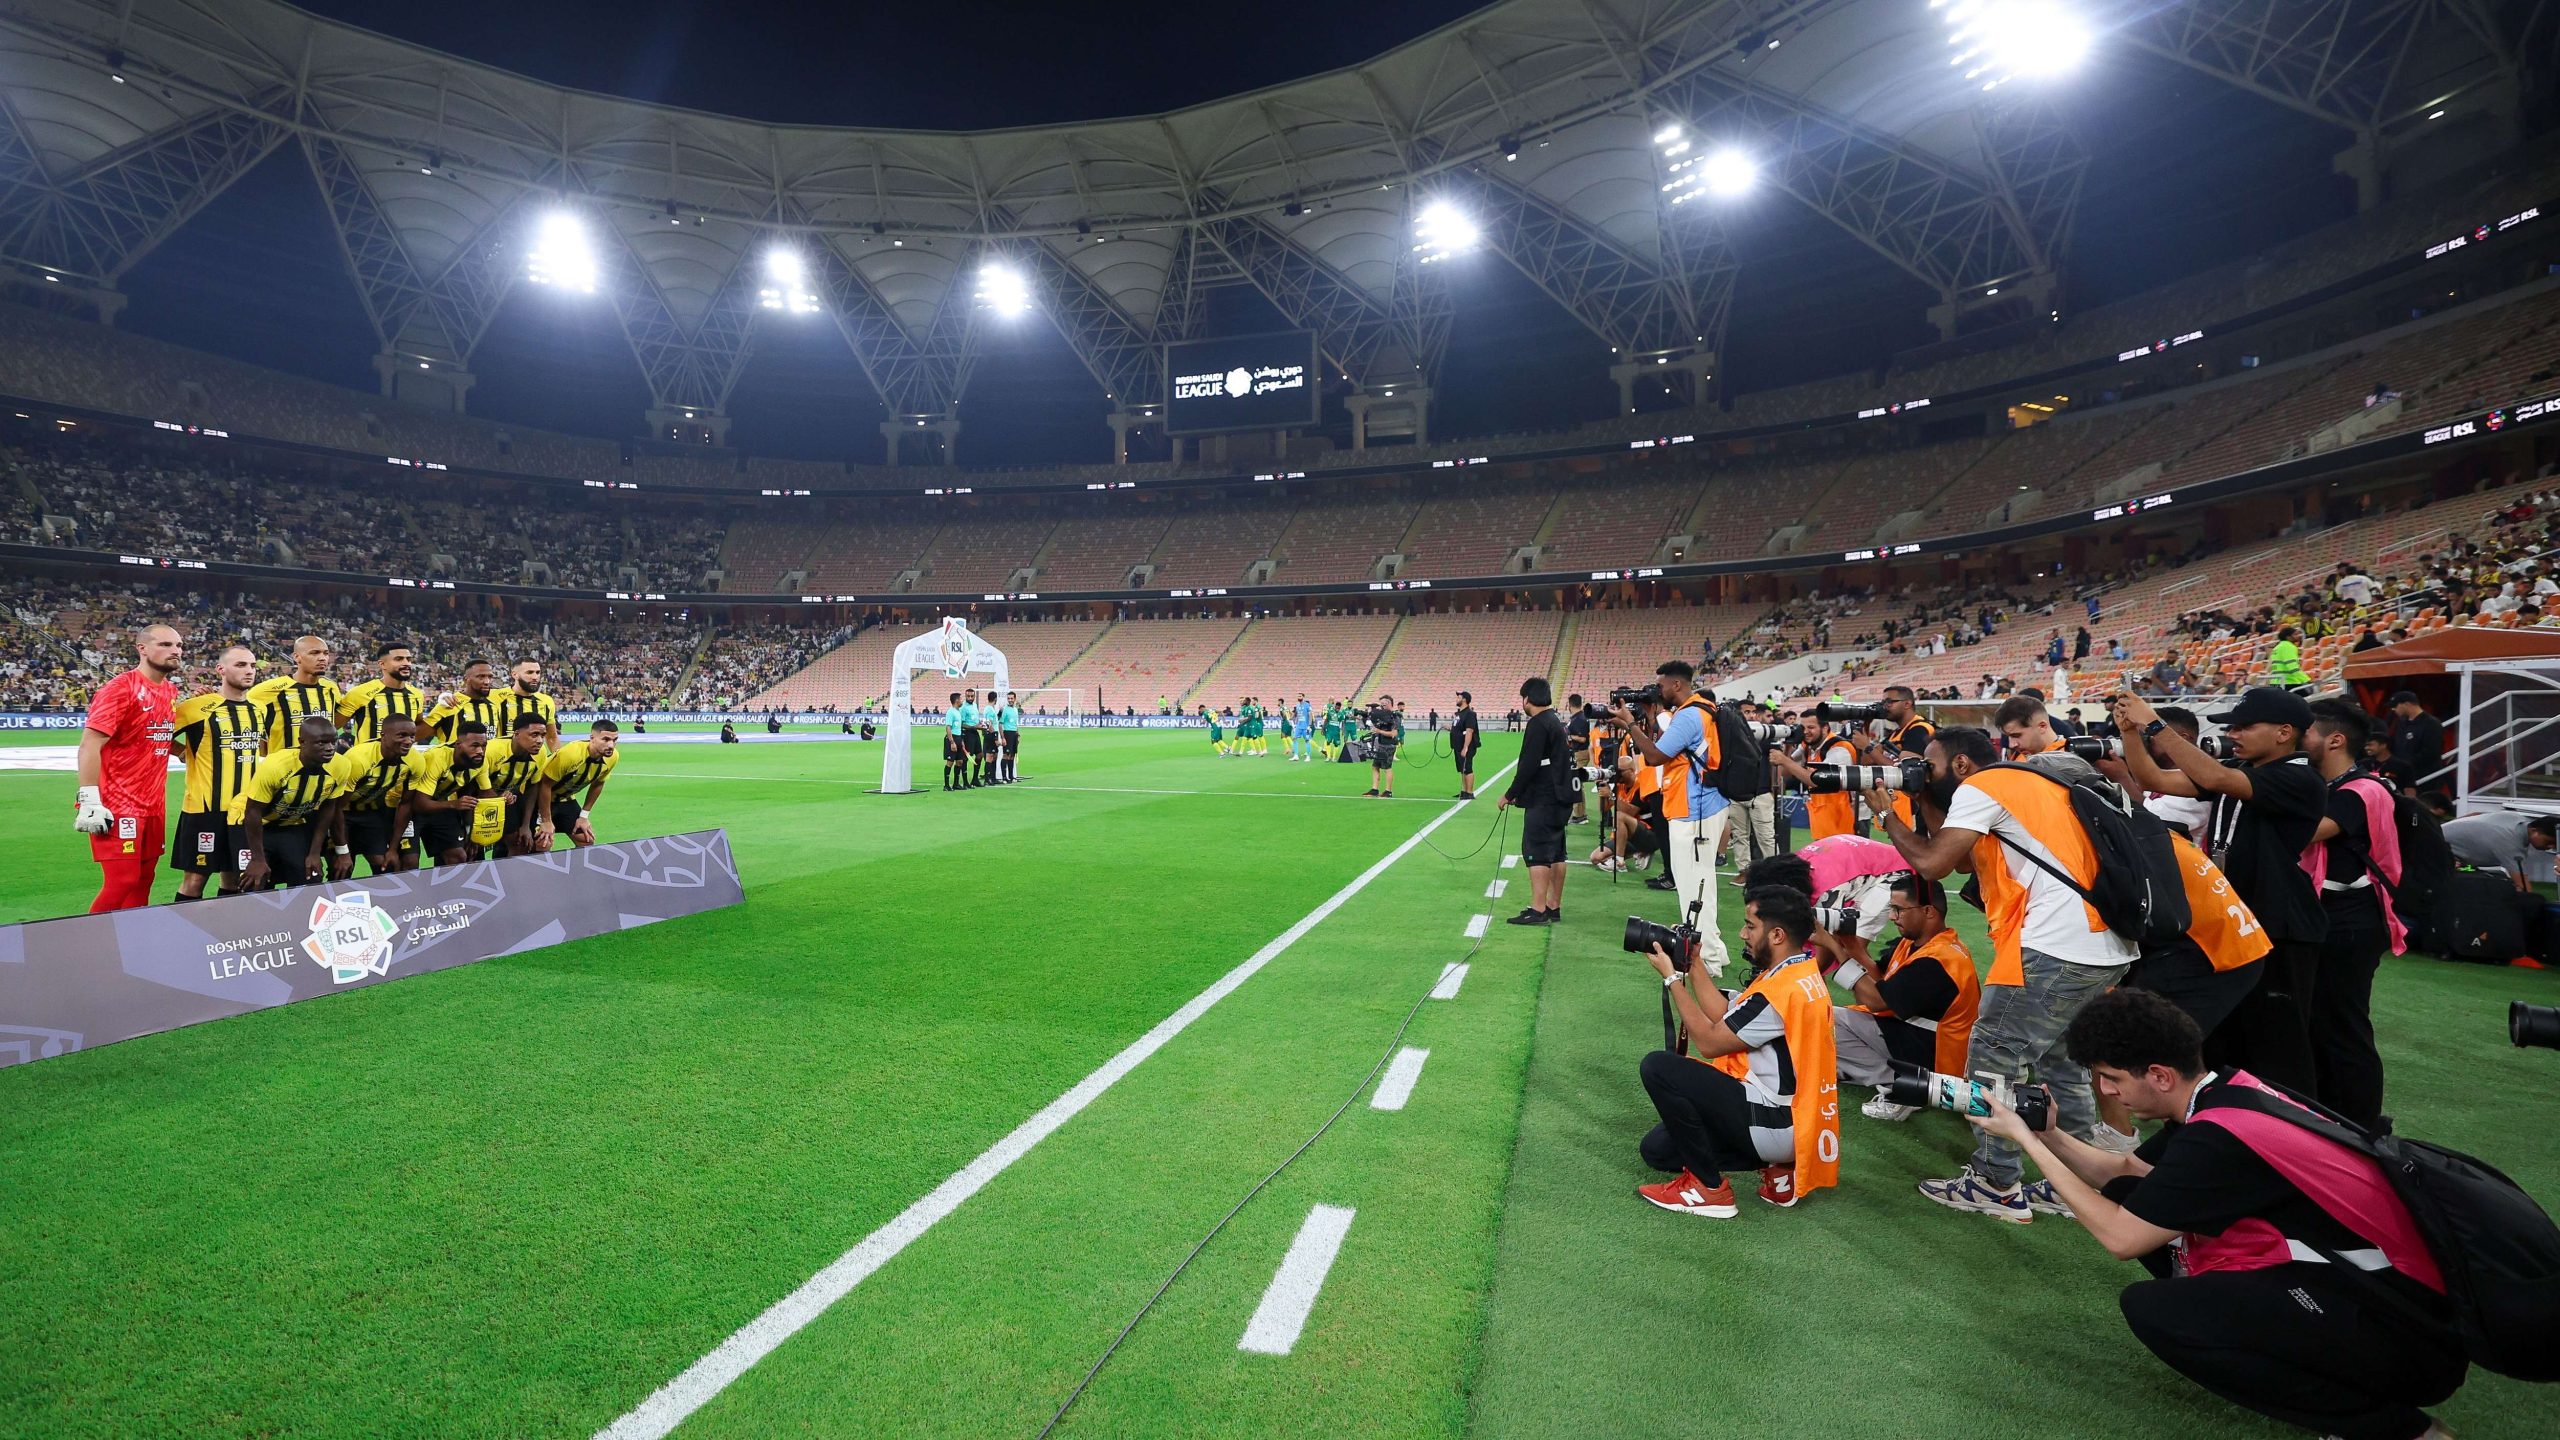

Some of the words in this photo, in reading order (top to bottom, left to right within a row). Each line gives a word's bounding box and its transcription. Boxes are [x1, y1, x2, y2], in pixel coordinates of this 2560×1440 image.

[1175, 382, 1223, 399] LEAGUE
[1253, 376, 1303, 395] السعودي
[2452, 421, 2477, 437] RSL
[951, 641, 963, 653] RSL
[915, 653, 936, 664] LEAGUE
[648, 714, 673, 723] ROSHN
[674, 714, 693, 723] SAUDI
[694, 714, 717, 723] LEAGUE
[747, 714, 766, 723] SAUDI
[799, 715, 823, 724] ROSHN
[824, 715, 845, 724] SAUDI
[910, 716, 926, 725] AUDI
[1108, 718, 1139, 727] LEAGUE
[1150, 718, 1180, 728] ROSHN
[231, 740, 260, 750] ROSHN
[402, 906, 436, 922] روشن
[437, 901, 466, 920] دوري
[407, 914, 470, 942] السعودي
[206, 937, 253, 956] ROSHN
[254, 930, 292, 948] SAUDI
[335, 927, 369, 946] RSL
[209, 946, 297, 980] LEAGUE
[1773, 1174, 1790, 1193] N
[1679, 1188, 1705, 1206] N
